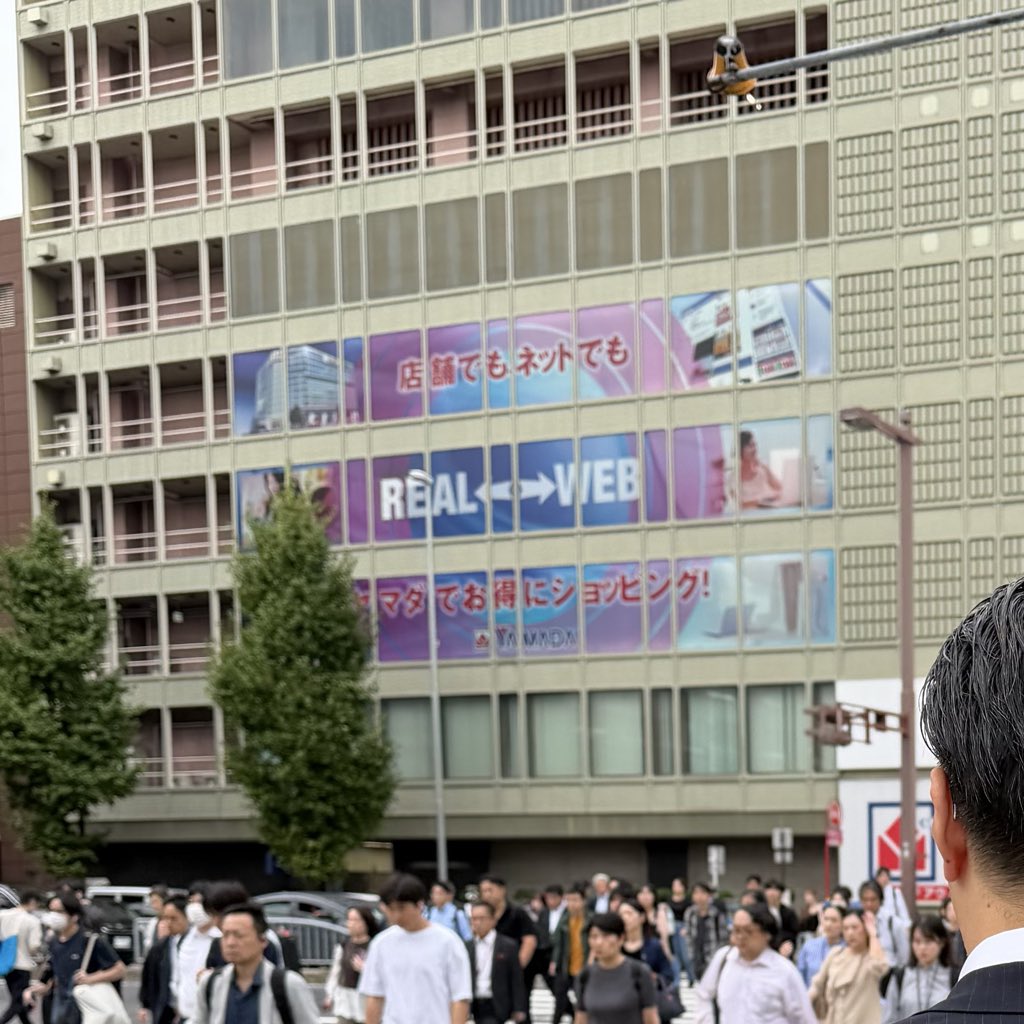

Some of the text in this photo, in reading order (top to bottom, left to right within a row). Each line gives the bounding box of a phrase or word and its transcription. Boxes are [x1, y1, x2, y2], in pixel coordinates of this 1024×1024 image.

[399, 335, 629, 391] 店舗でもネットでも
[380, 471, 478, 521] REAL
[554, 458, 640, 507] WEB
